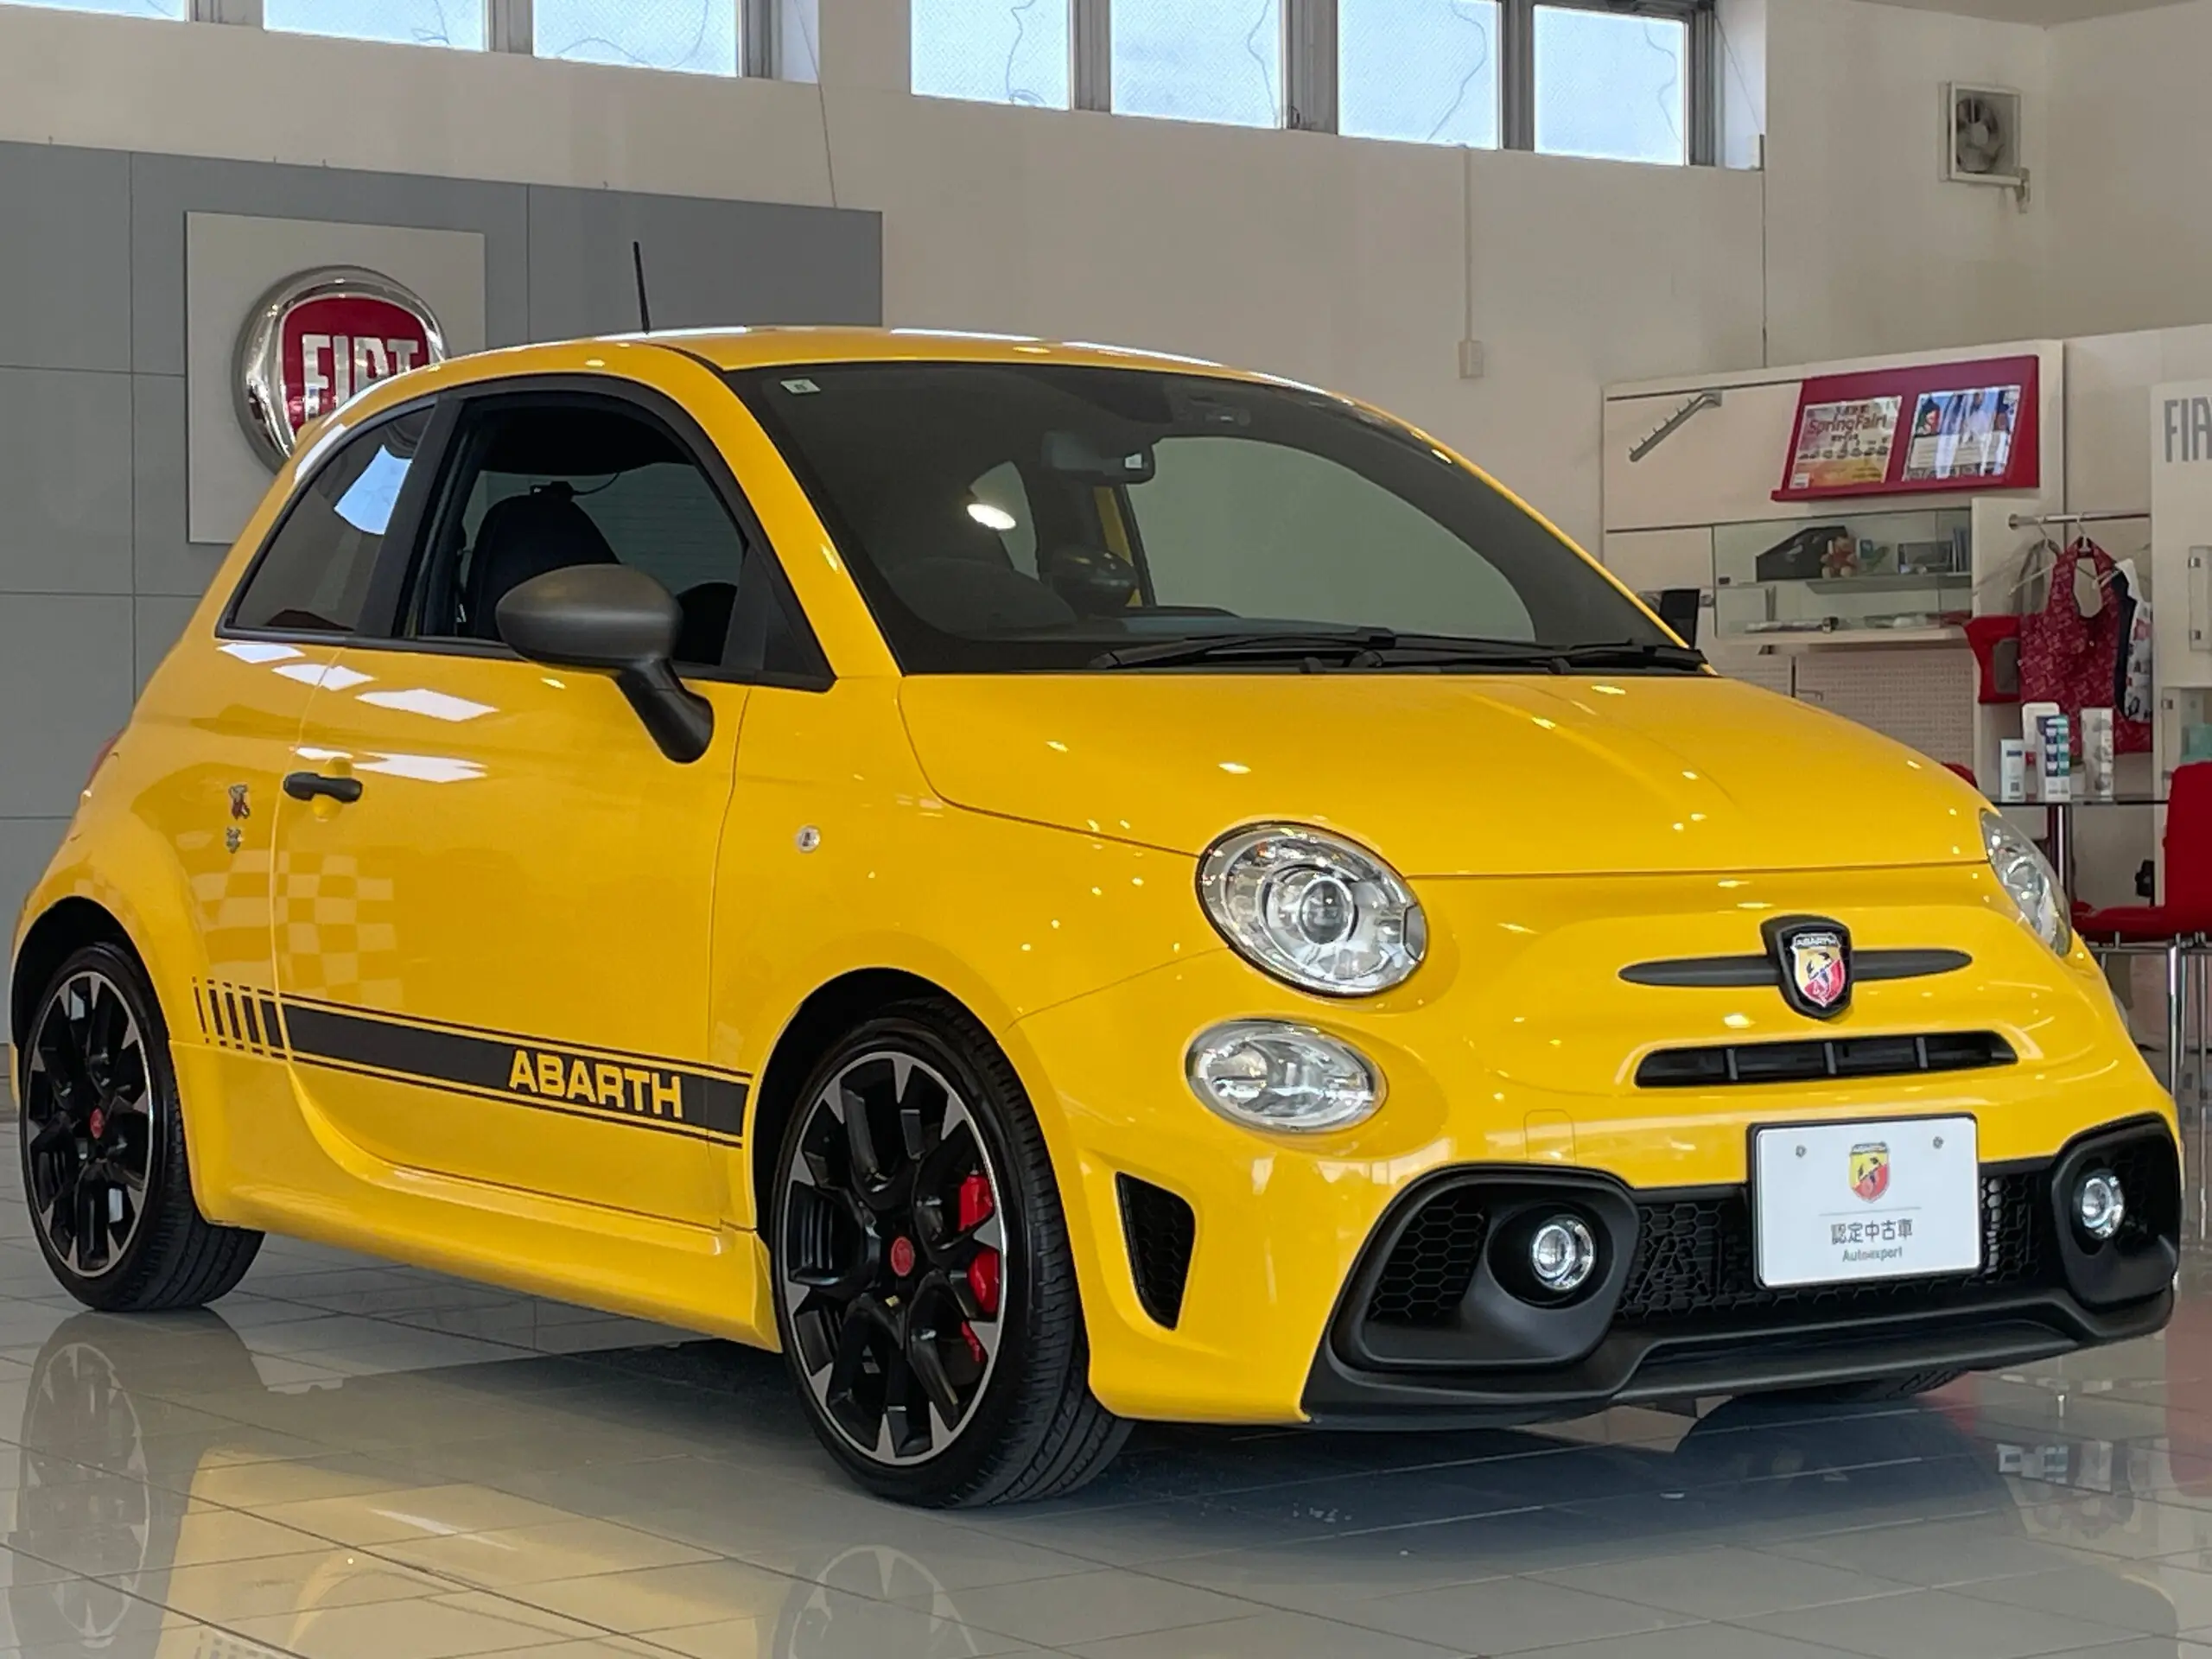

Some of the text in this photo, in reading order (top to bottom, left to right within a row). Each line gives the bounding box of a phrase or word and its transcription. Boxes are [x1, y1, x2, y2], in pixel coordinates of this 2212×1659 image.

[2164, 397, 2212, 463] FIA
[507, 1047, 683, 1119] ABARTH
[1830, 1217, 1913, 1245] 認定中古車
